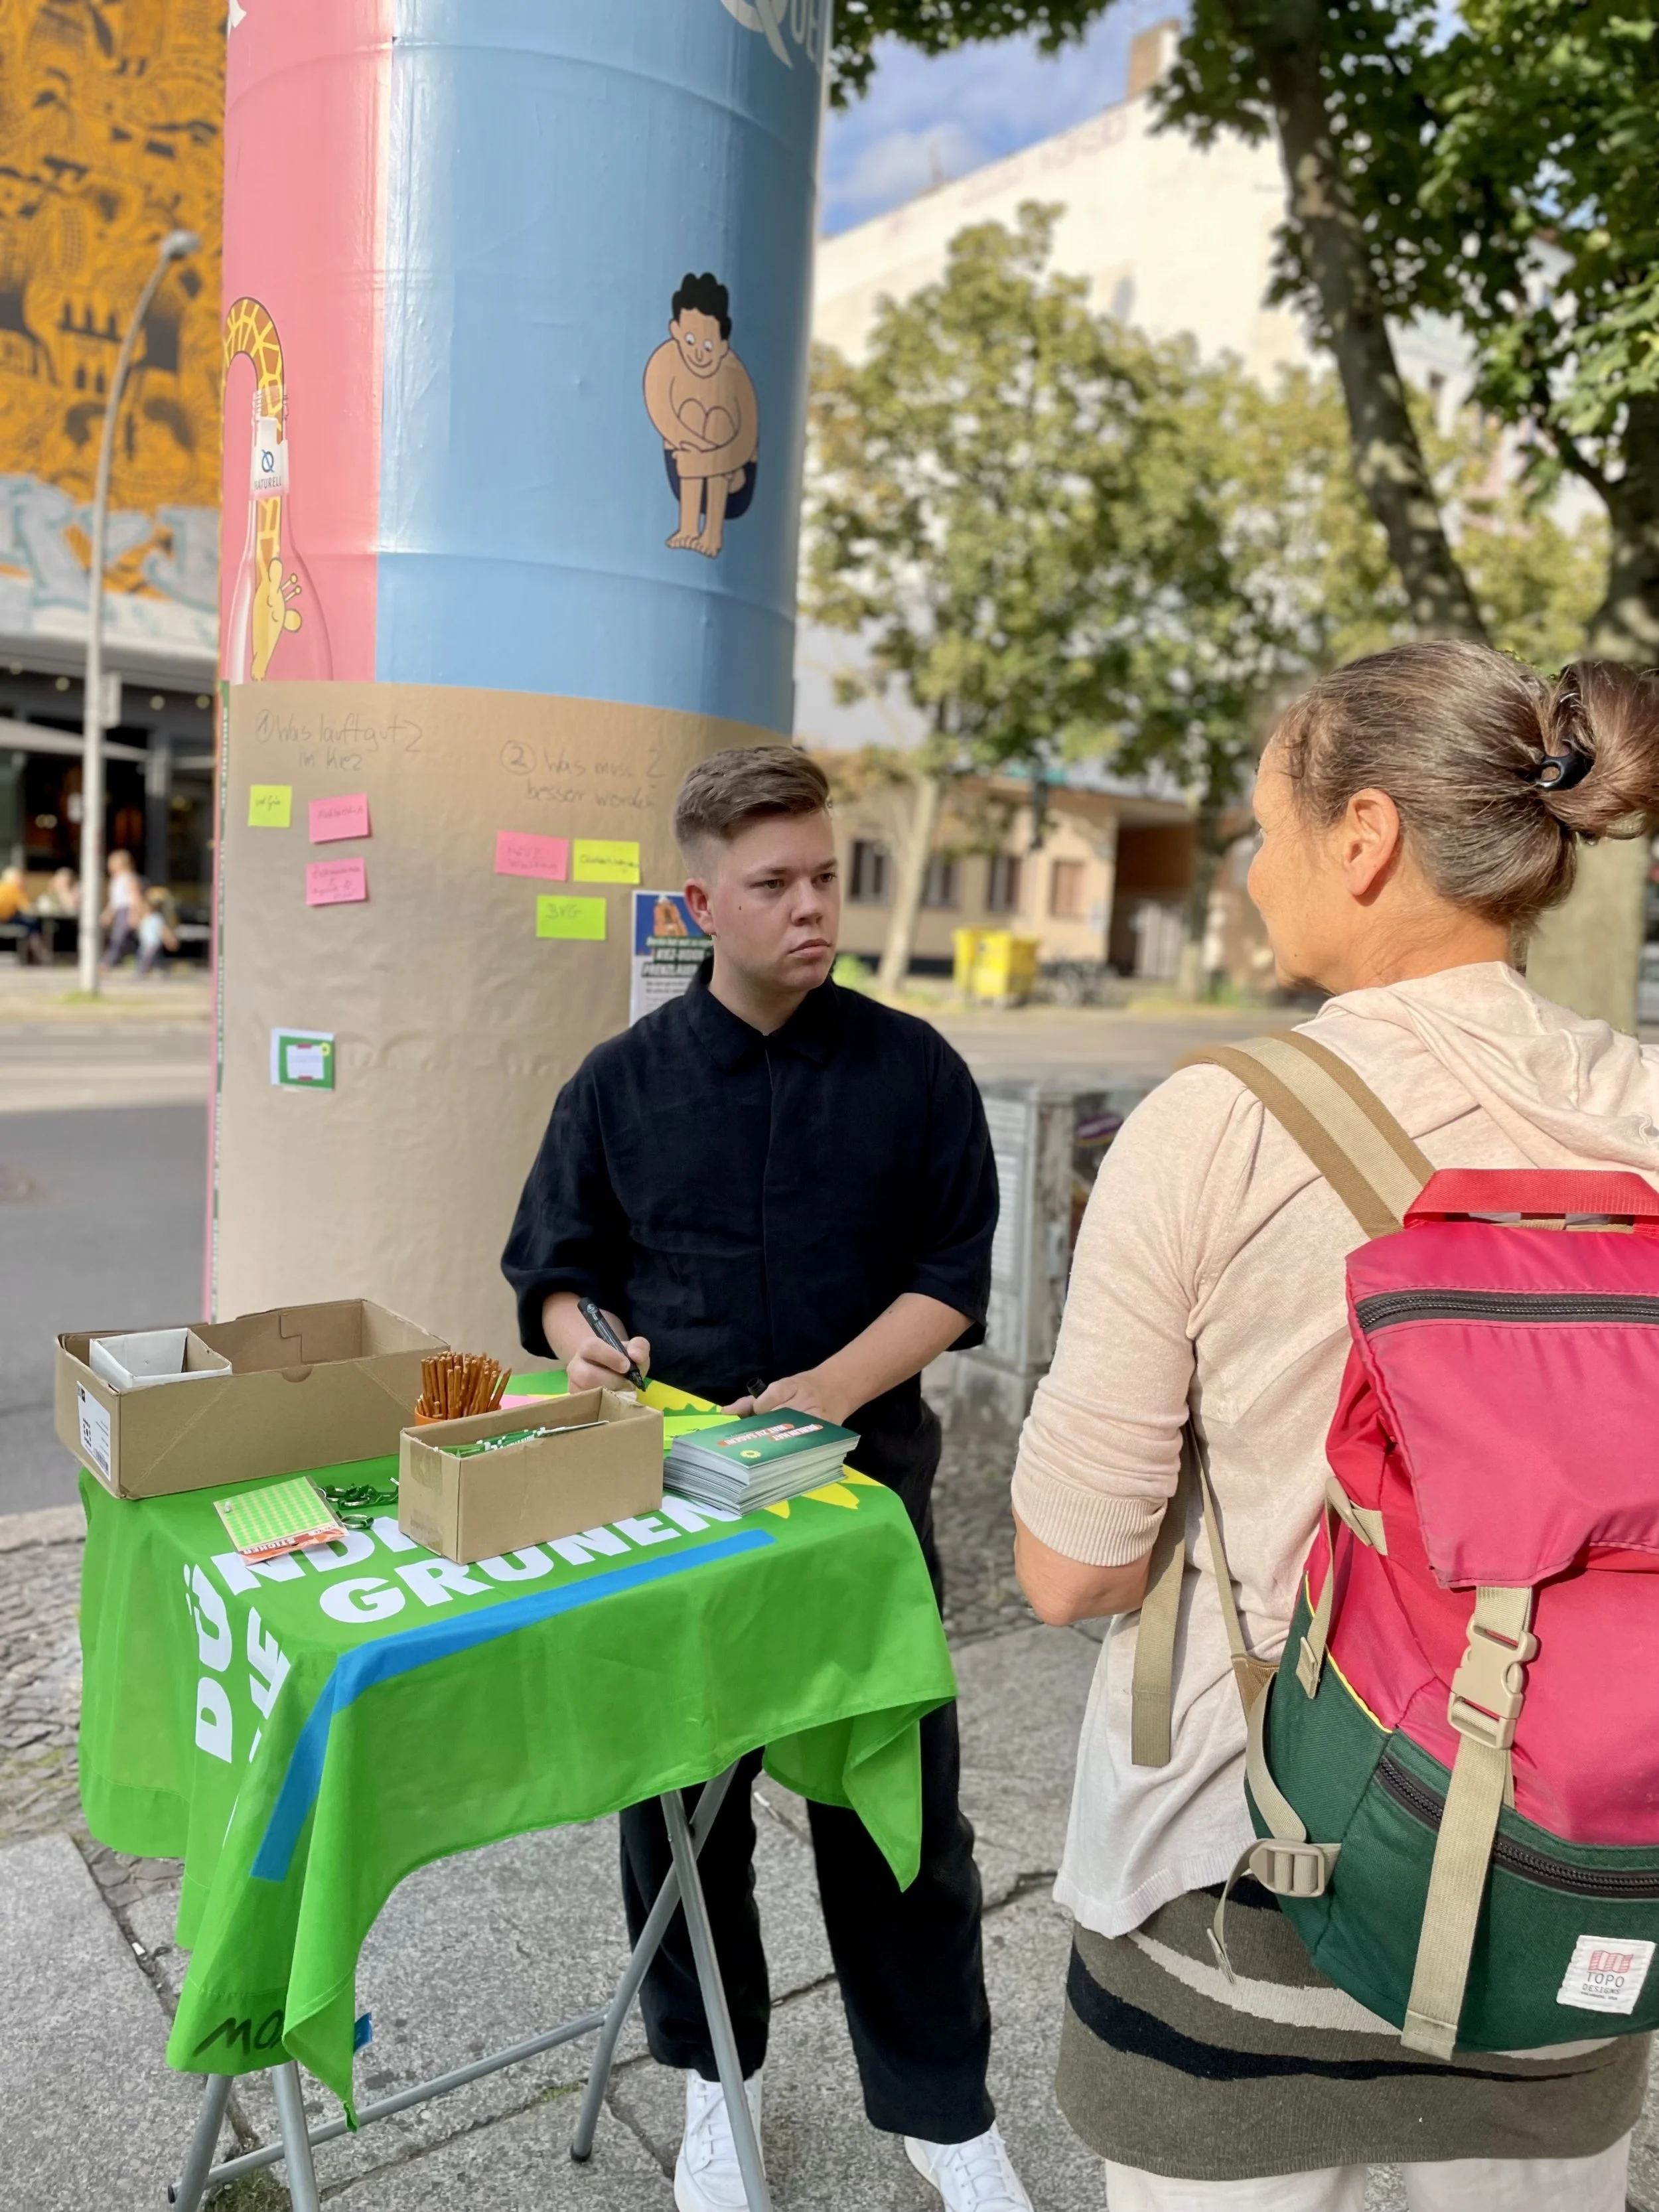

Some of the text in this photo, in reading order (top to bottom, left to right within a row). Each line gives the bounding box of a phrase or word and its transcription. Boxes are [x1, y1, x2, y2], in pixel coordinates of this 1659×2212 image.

[253, 476, 282, 491] NATURELL
[277, 712, 312, 743] Was
[543, 747, 587, 776] Was
[244, 1538, 296, 1555] STICKER
[1587, 1971, 1624, 1988] TOPO
[1582, 1983, 1622, 1995] DESIGNS
